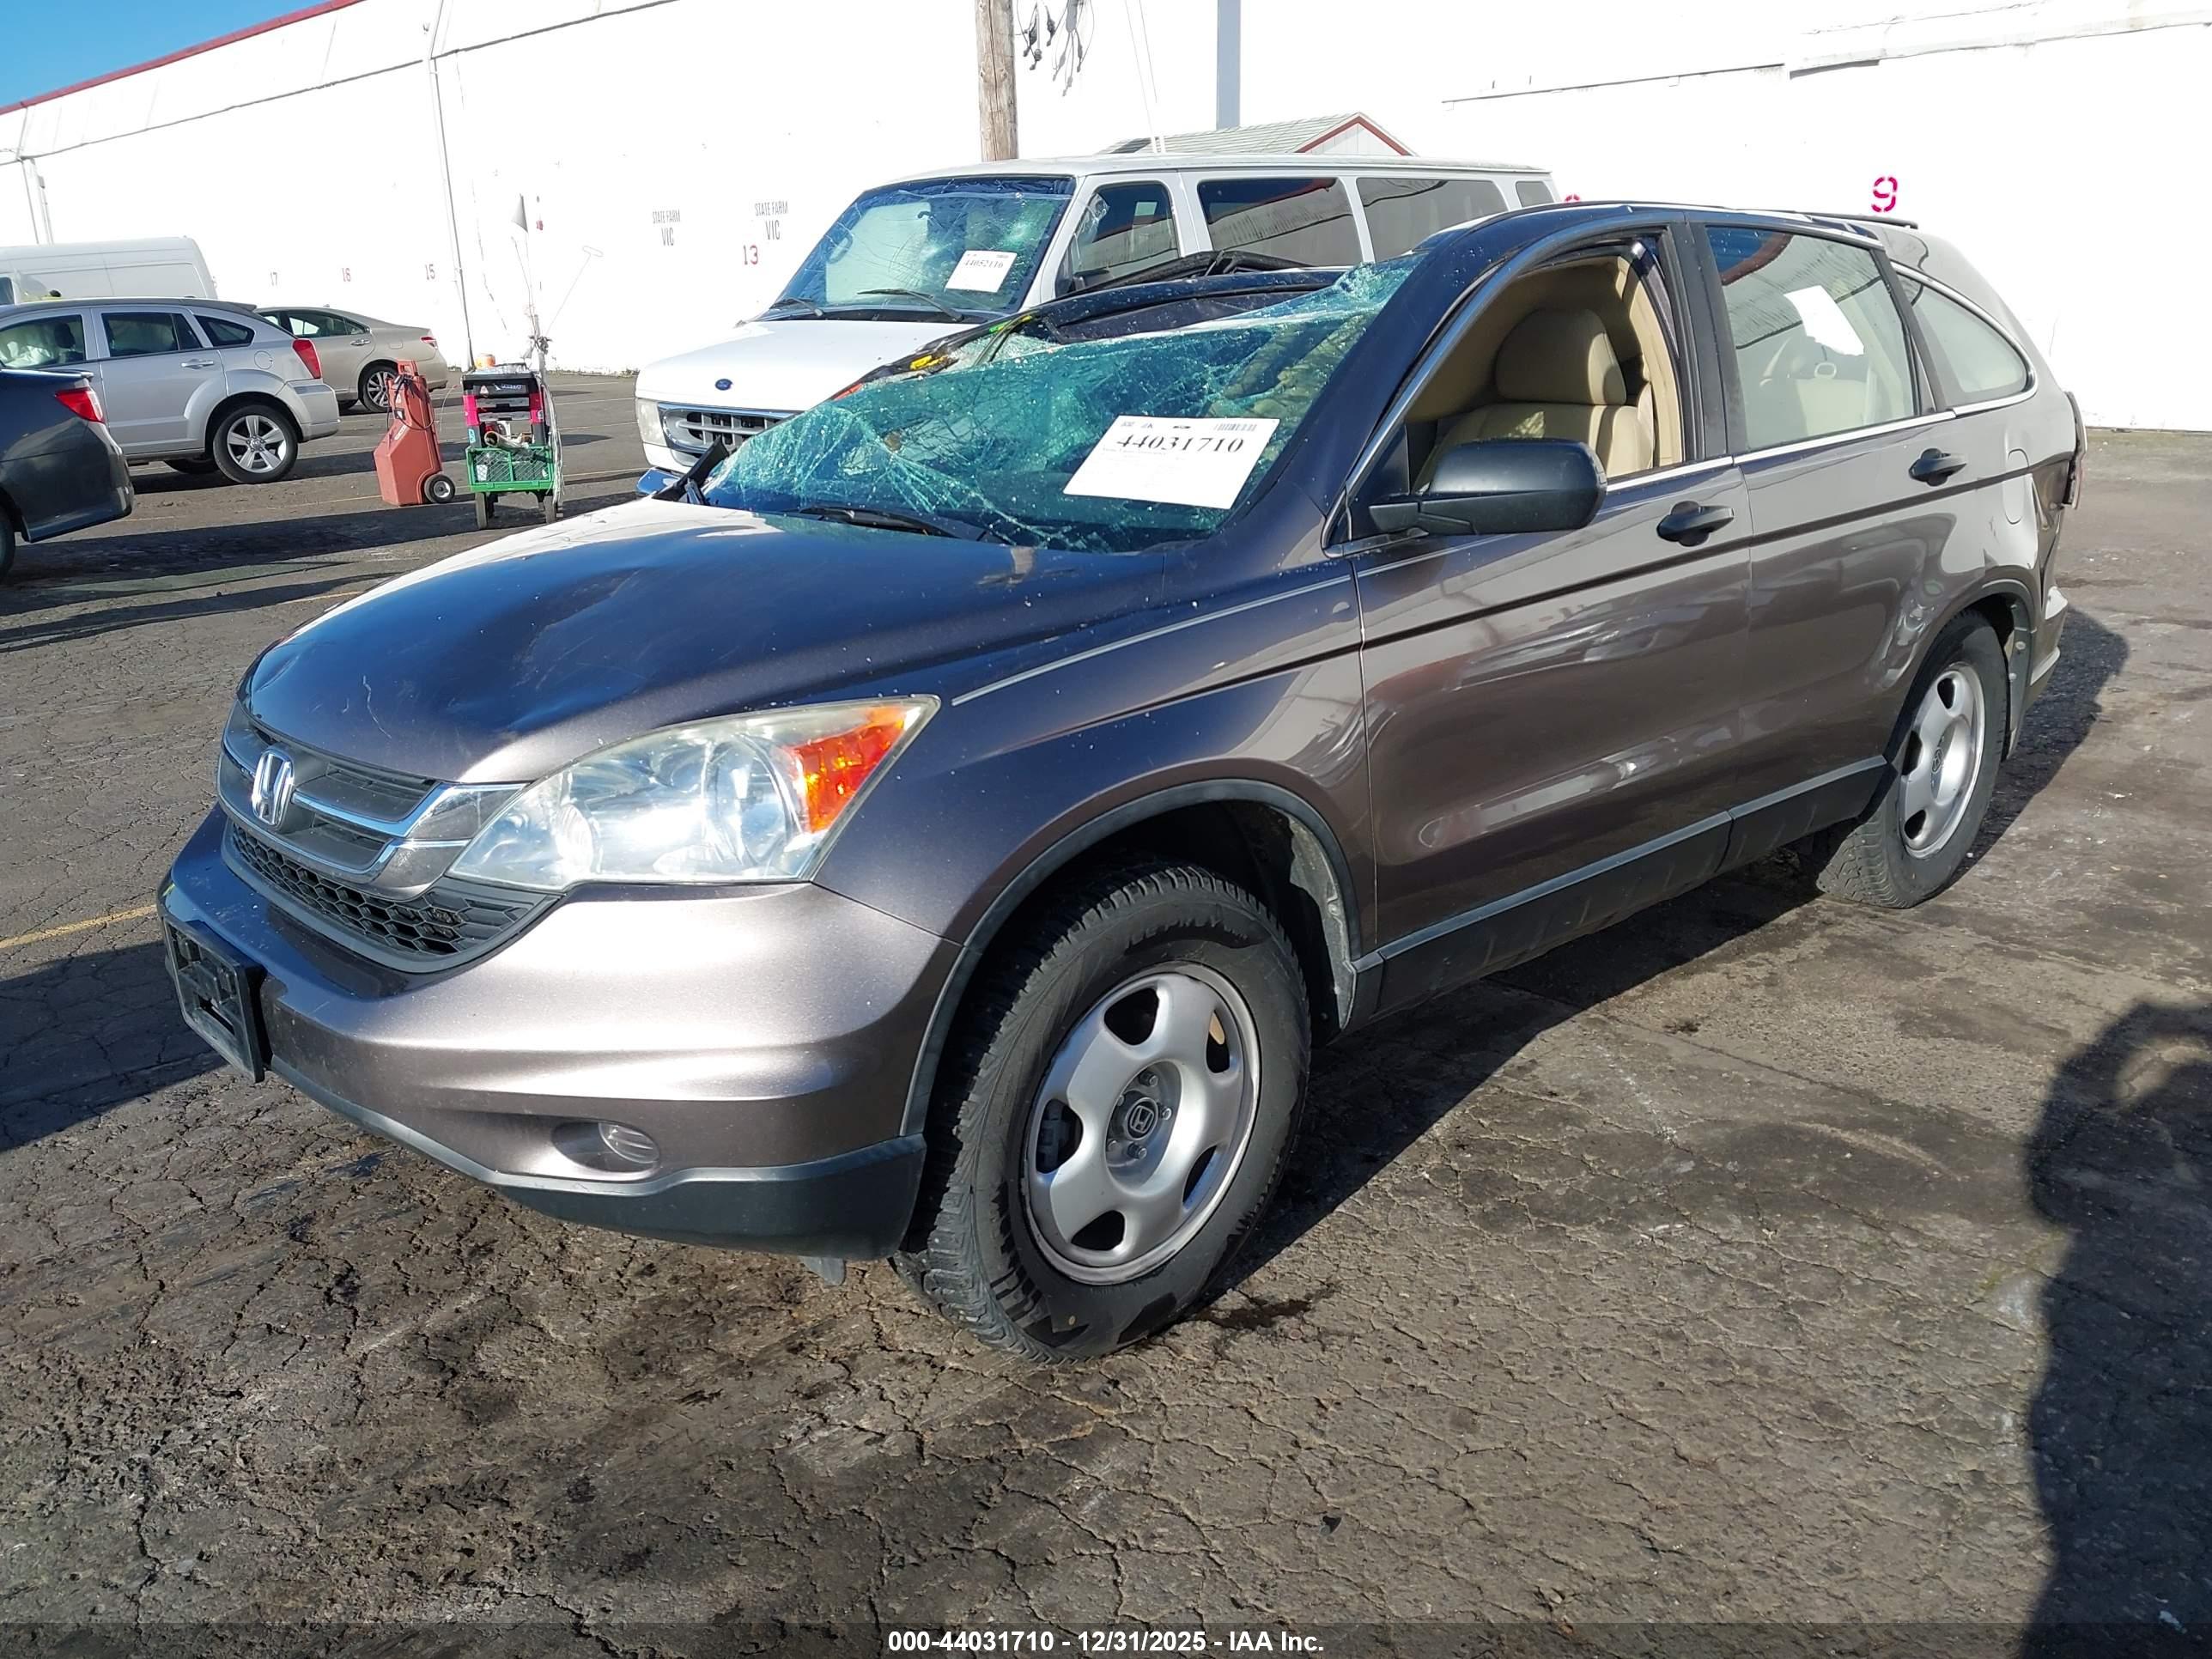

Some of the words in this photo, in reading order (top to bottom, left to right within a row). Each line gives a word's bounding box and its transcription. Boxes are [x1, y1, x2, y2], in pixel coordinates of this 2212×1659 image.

[1871, 176, 1898, 212] 9
[653, 210, 665, 223] STATE
[666, 209, 680, 222] FARM
[755, 203, 770, 216] STATE
[772, 200, 787, 214] FARM
[661, 227, 674, 246] VIC
[765, 219, 780, 240] VIC
[743, 244, 758, 264] 13
[270, 271, 277, 285] 17
[342, 267, 350, 282] 16
[425, 264, 435, 280] 15
[1115, 434, 1244, 453] 44031710
